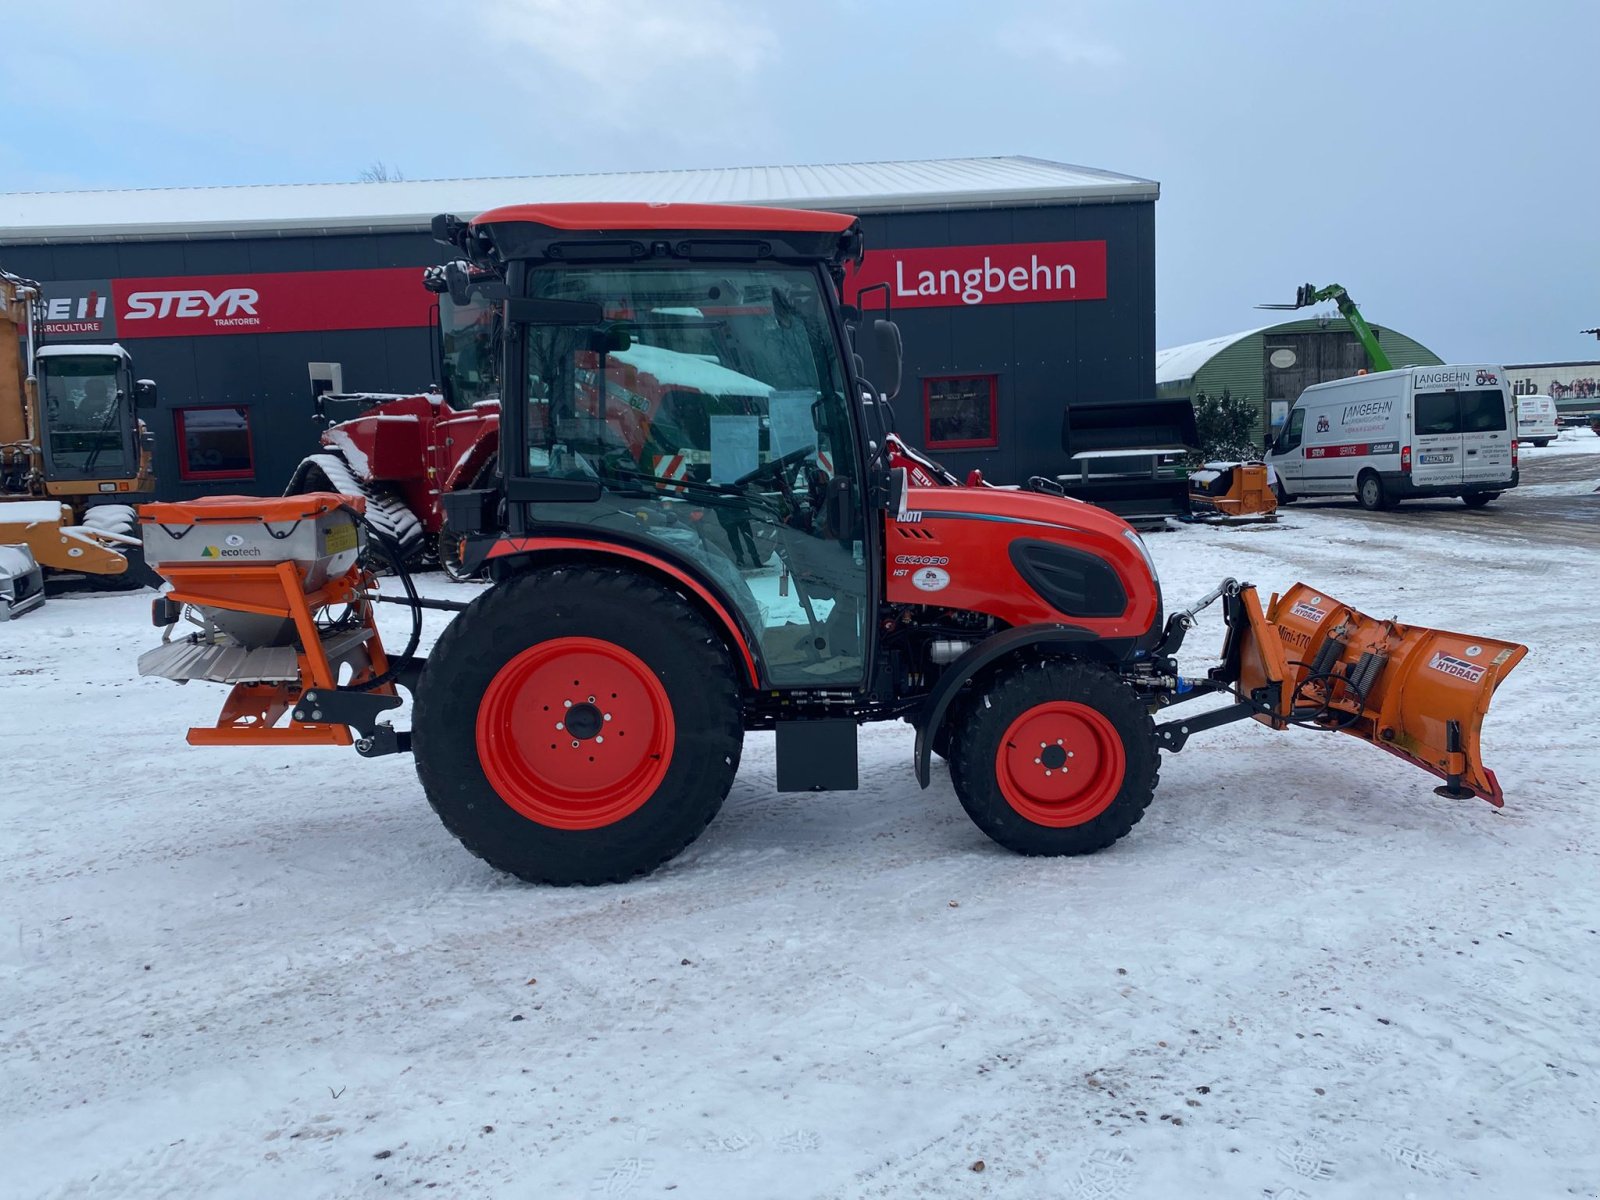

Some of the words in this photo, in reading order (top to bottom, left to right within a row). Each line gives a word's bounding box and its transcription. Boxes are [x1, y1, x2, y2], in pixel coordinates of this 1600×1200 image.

[896, 254, 1076, 304] Langbehn
[124, 288, 259, 320] STEYR
[214, 318, 260, 327] TRAKTOREN
[1414, 372, 1470, 390] LANGBEHN
[1341, 400, 1393, 425] LANGBEHN
[221, 546, 261, 557] ecotech
[895, 555, 950, 566] CK4030
[893, 569, 909, 577] HST
[1294, 607, 1321, 621] HYDRAC
[1436, 661, 1479, 681] HYDRAC
